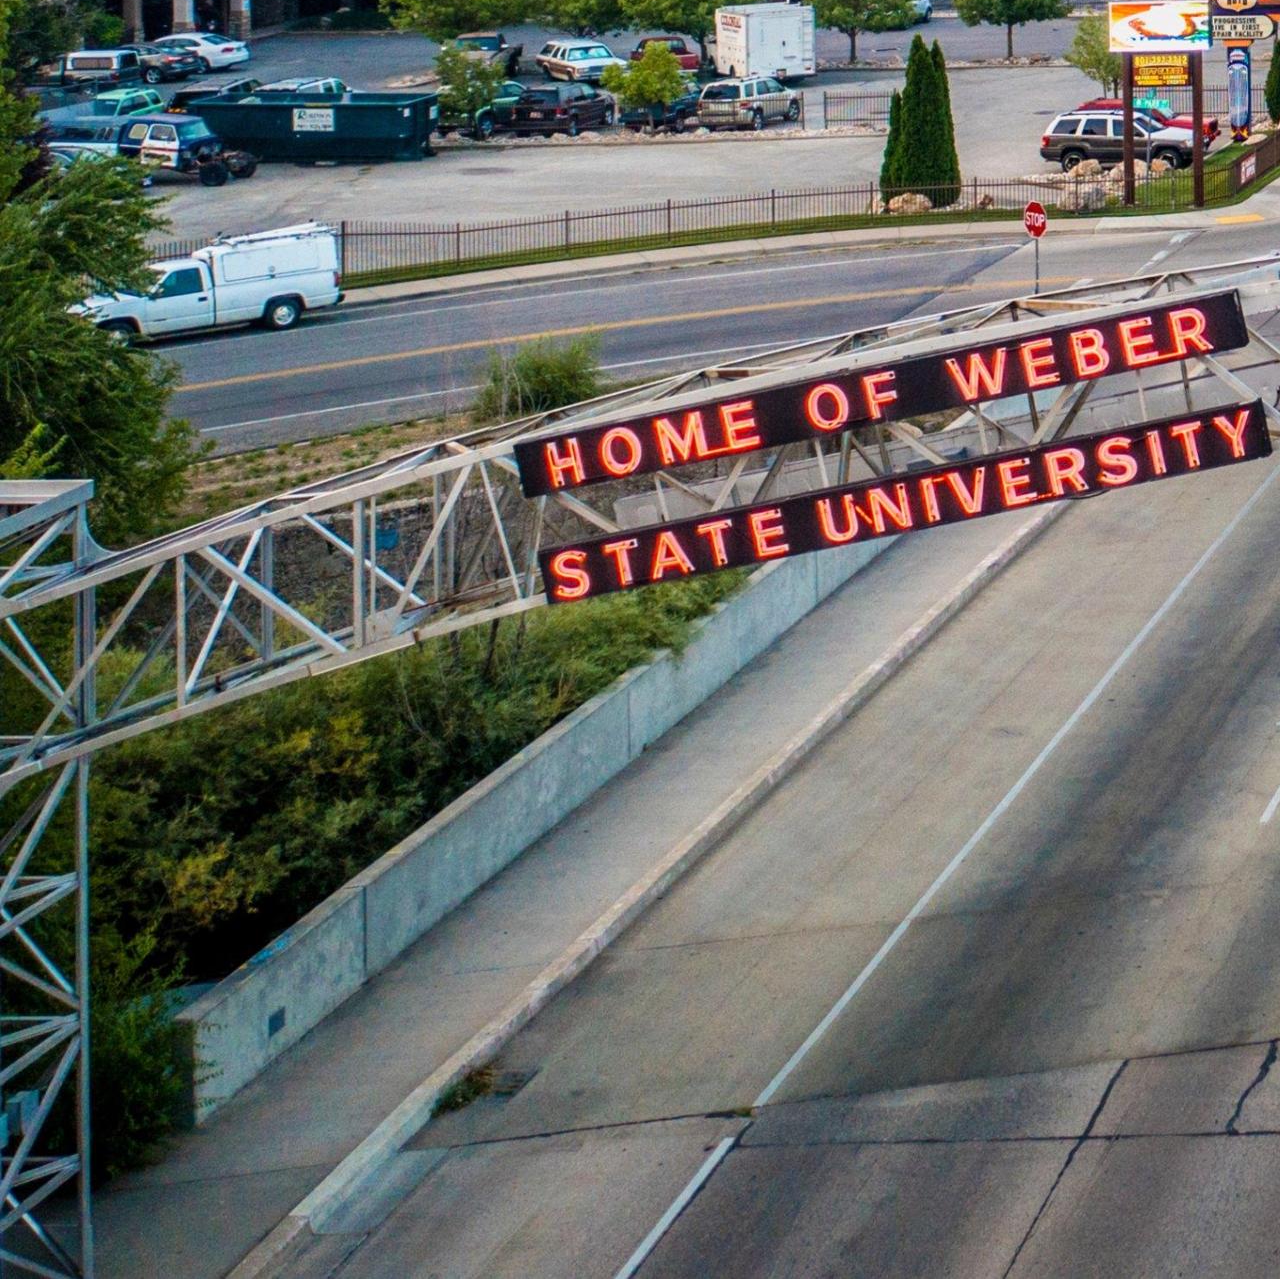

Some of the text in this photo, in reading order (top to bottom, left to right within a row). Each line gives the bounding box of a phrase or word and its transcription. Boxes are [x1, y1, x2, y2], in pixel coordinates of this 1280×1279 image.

[1026, 212, 1045, 227] STOP
[545, 307, 1214, 488] HOME OF WEBER
[550, 409, 1251, 599] STATE UNIVERSITY
